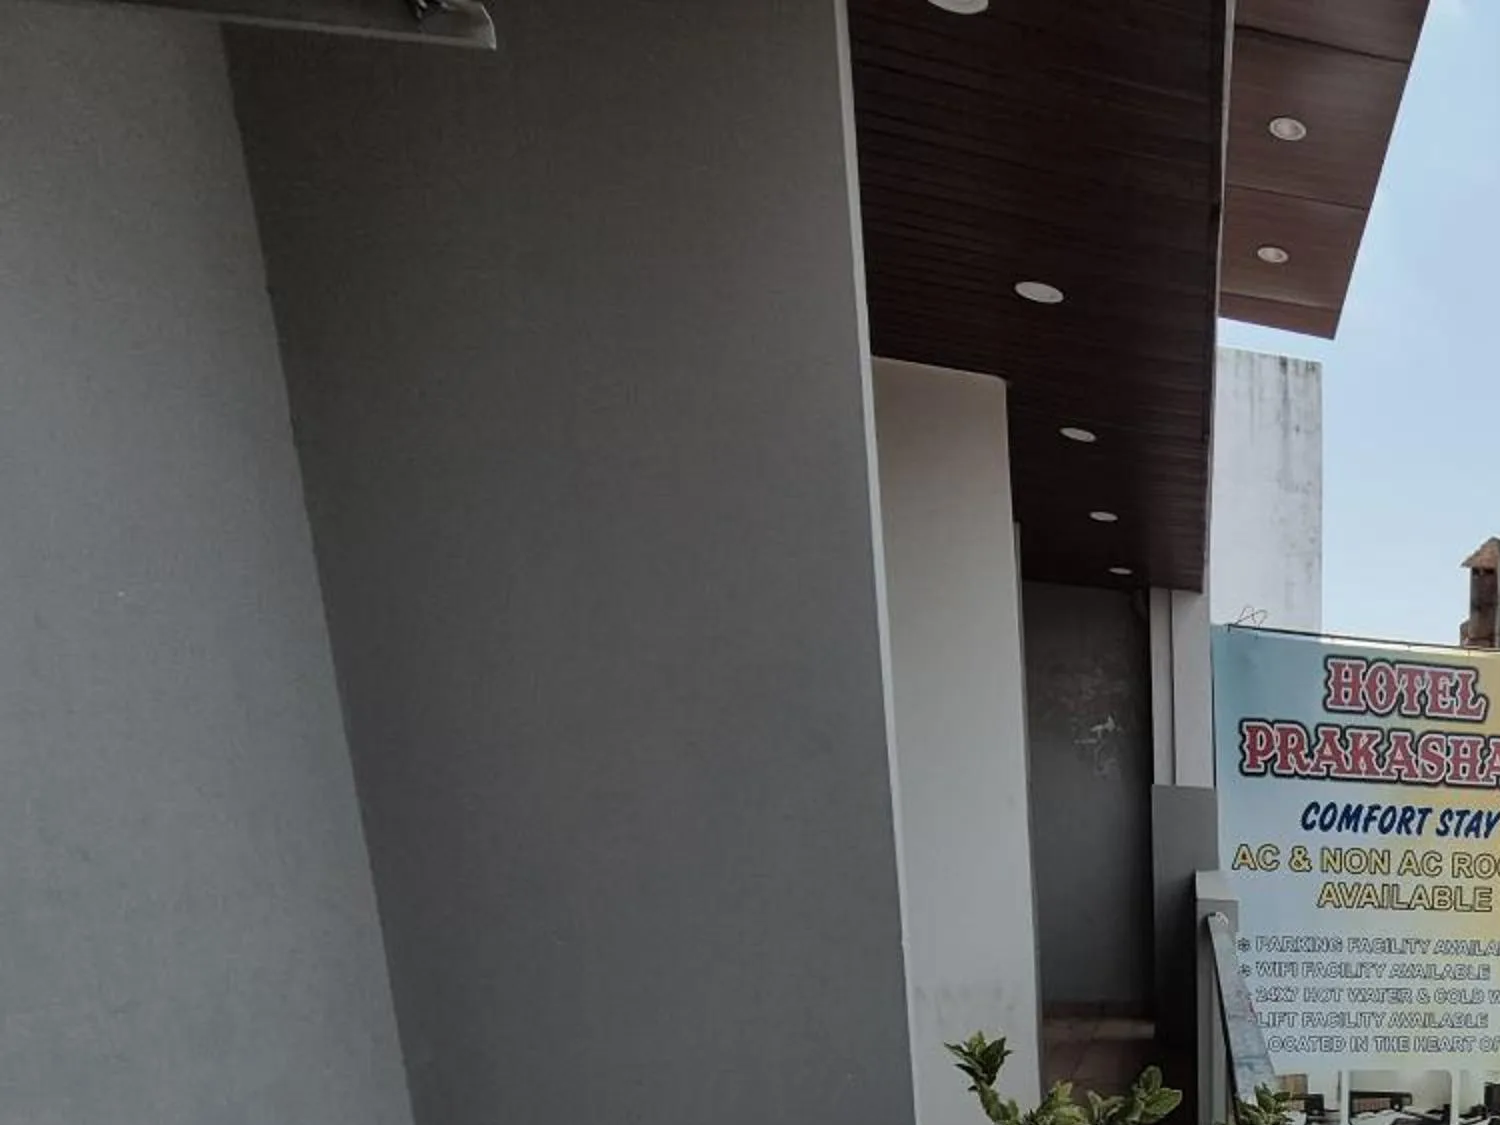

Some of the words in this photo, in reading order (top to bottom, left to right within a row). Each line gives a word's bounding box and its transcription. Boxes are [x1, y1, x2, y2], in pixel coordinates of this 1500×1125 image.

[1324, 655, 1489, 722] HOTEL
[1300, 801, 1433, 837] COMFORT
[1231, 843, 1280, 872] AC
[1288, 845, 1312, 873] &
[1320, 847, 1391, 875] NON
[1399, 850, 1442, 878] AC
[1317, 881, 1494, 912] AVAILABLE
[1255, 935, 1343, 954] PARKING
[1347, 936, 1433, 956] FACILITY
[1255, 962, 1299, 978] WIFI
[1301, 962, 1388, 980] FACILITY
[1388, 963, 1491, 981] AVAILABLE
[1303, 988, 1346, 1004] HOT
[1348, 988, 1411, 1005] WATER
[1256, 1011, 1300, 1028] LIFT
[1301, 1011, 1387, 1029] FACILITY
[1387, 1012, 1489, 1030] AVAILABLE
[1266, 1036, 1347, 1054] OCATED
[1350, 1036, 1370, 1053] IN
[1373, 1036, 1409, 1053] THE
[1413, 1036, 1477, 1053] HEART
